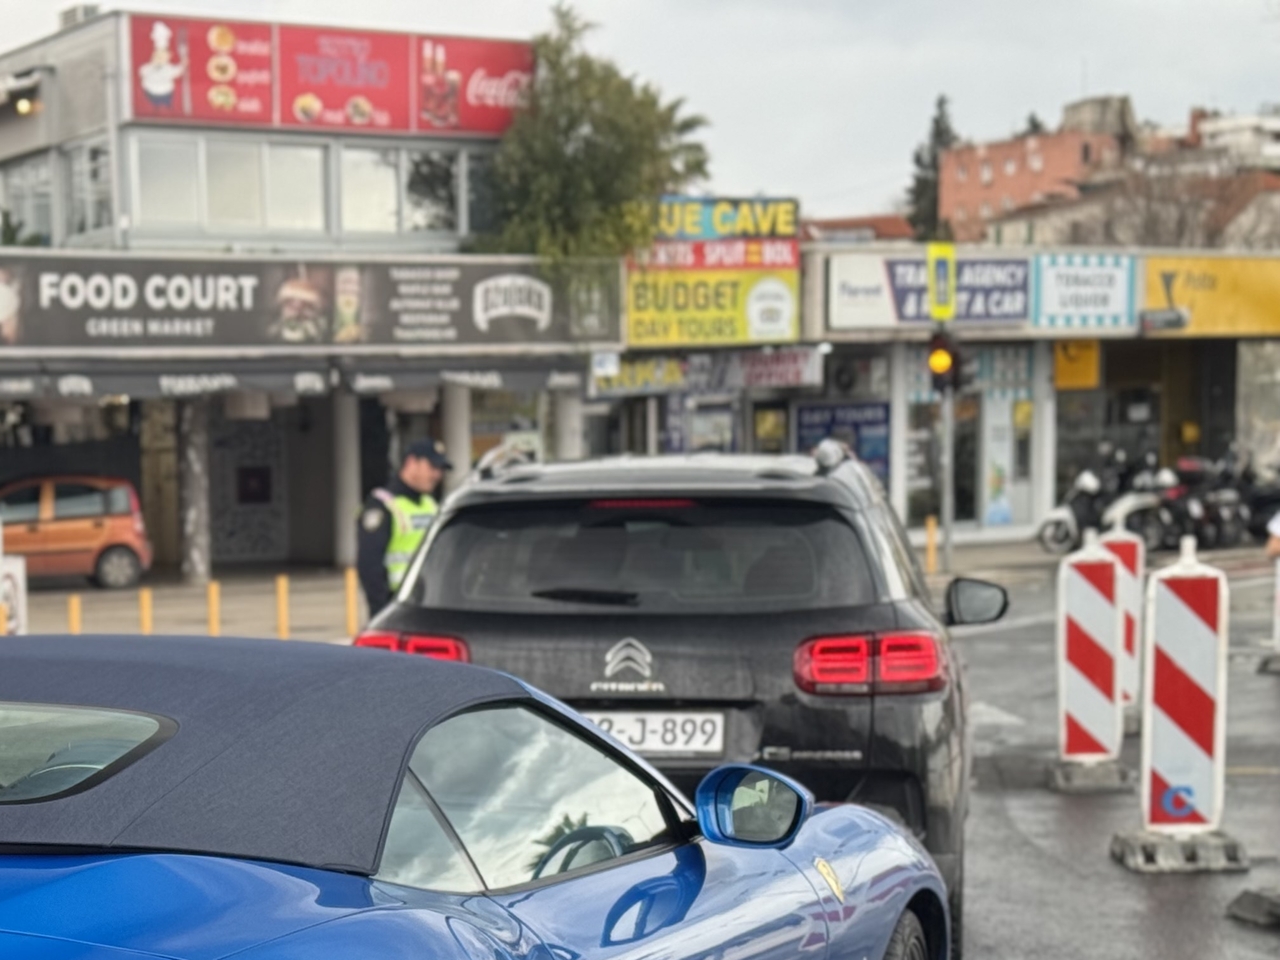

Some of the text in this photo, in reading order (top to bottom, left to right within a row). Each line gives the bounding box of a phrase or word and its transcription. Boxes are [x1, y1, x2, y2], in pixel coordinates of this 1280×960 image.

[712, 201, 797, 237] CAVE
[961, 263, 1027, 288] AGENCY
[1055, 273, 1116, 289] TOBACCO
[38, 273, 259, 311] FOOD COURT
[634, 280, 741, 312] BUDGET
[970, 291, 985, 317] A
[988, 291, 1026, 317] CAR
[1058, 292, 1110, 309] LIQUOR
[85, 317, 215, 337] GREEN MARKET
[634, 318, 738, 337] DAY TOURS
